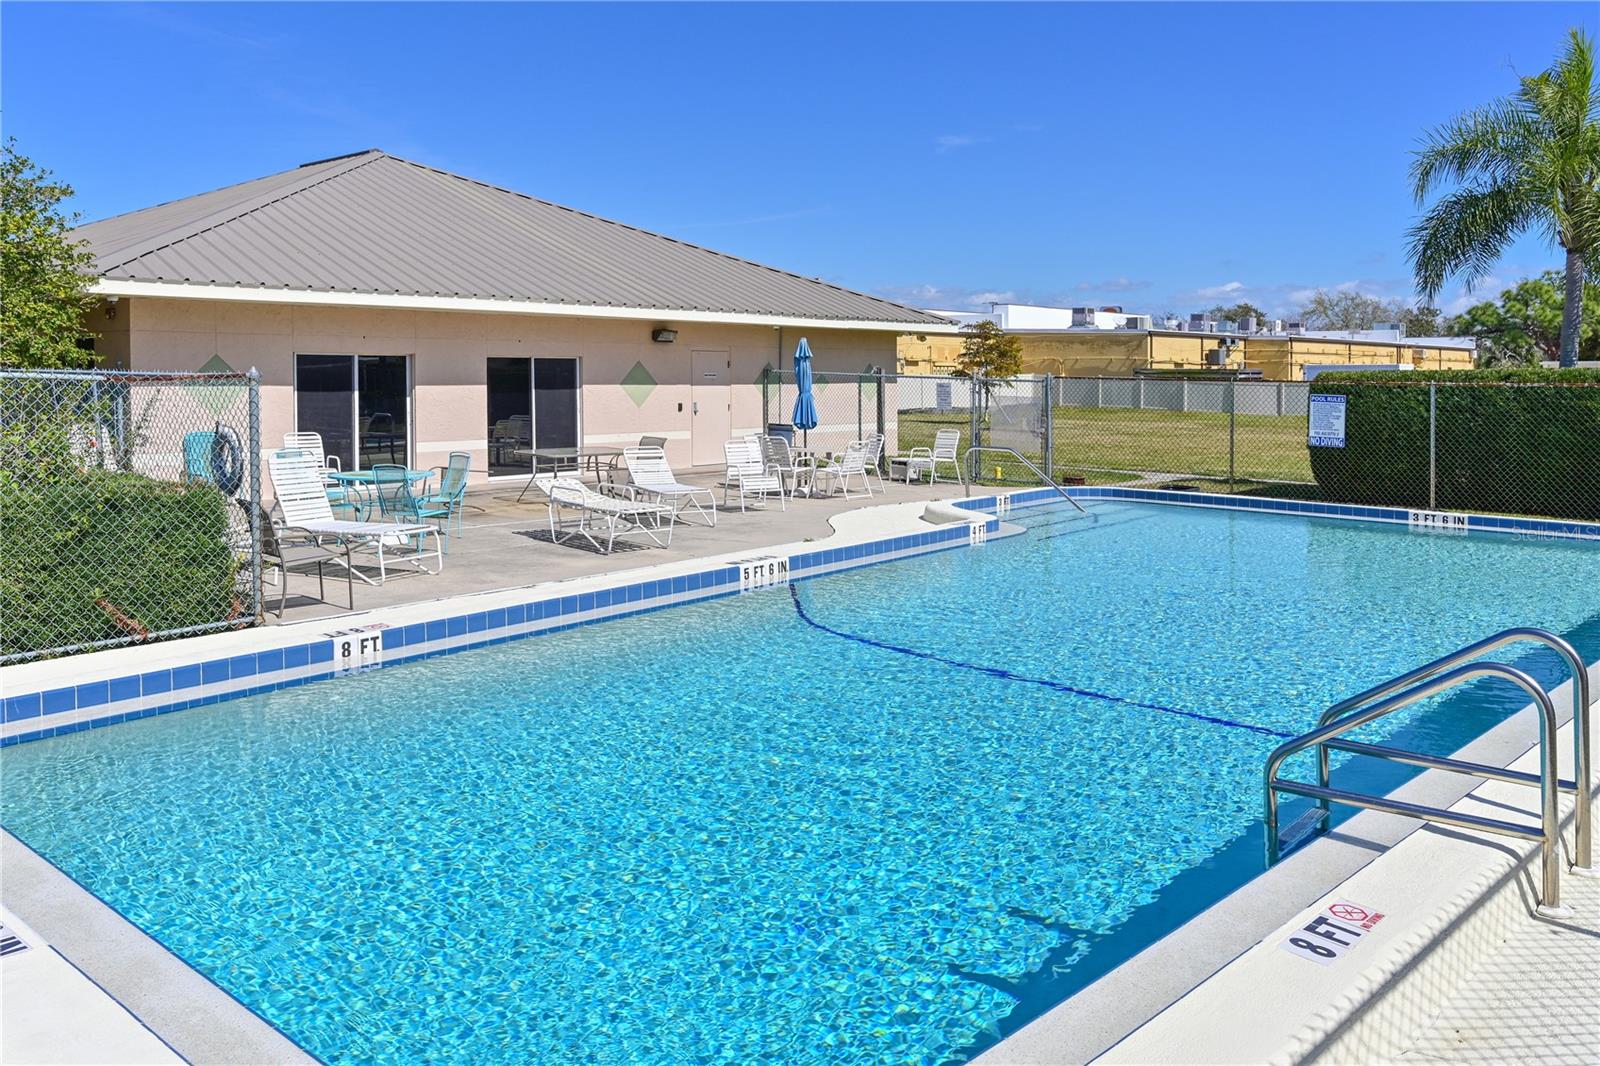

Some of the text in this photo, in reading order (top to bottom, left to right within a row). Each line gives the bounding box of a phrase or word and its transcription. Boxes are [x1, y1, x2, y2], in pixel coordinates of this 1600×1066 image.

[1310, 436, 1344, 447] NO DIVING
[1412, 513, 1465, 525] 3 FT 6 IN
[743, 567, 750, 580] 5
[768, 562, 775, 575] 6
[341, 641, 352, 658] 8
[1288, 915, 1362, 958] 8 FT
